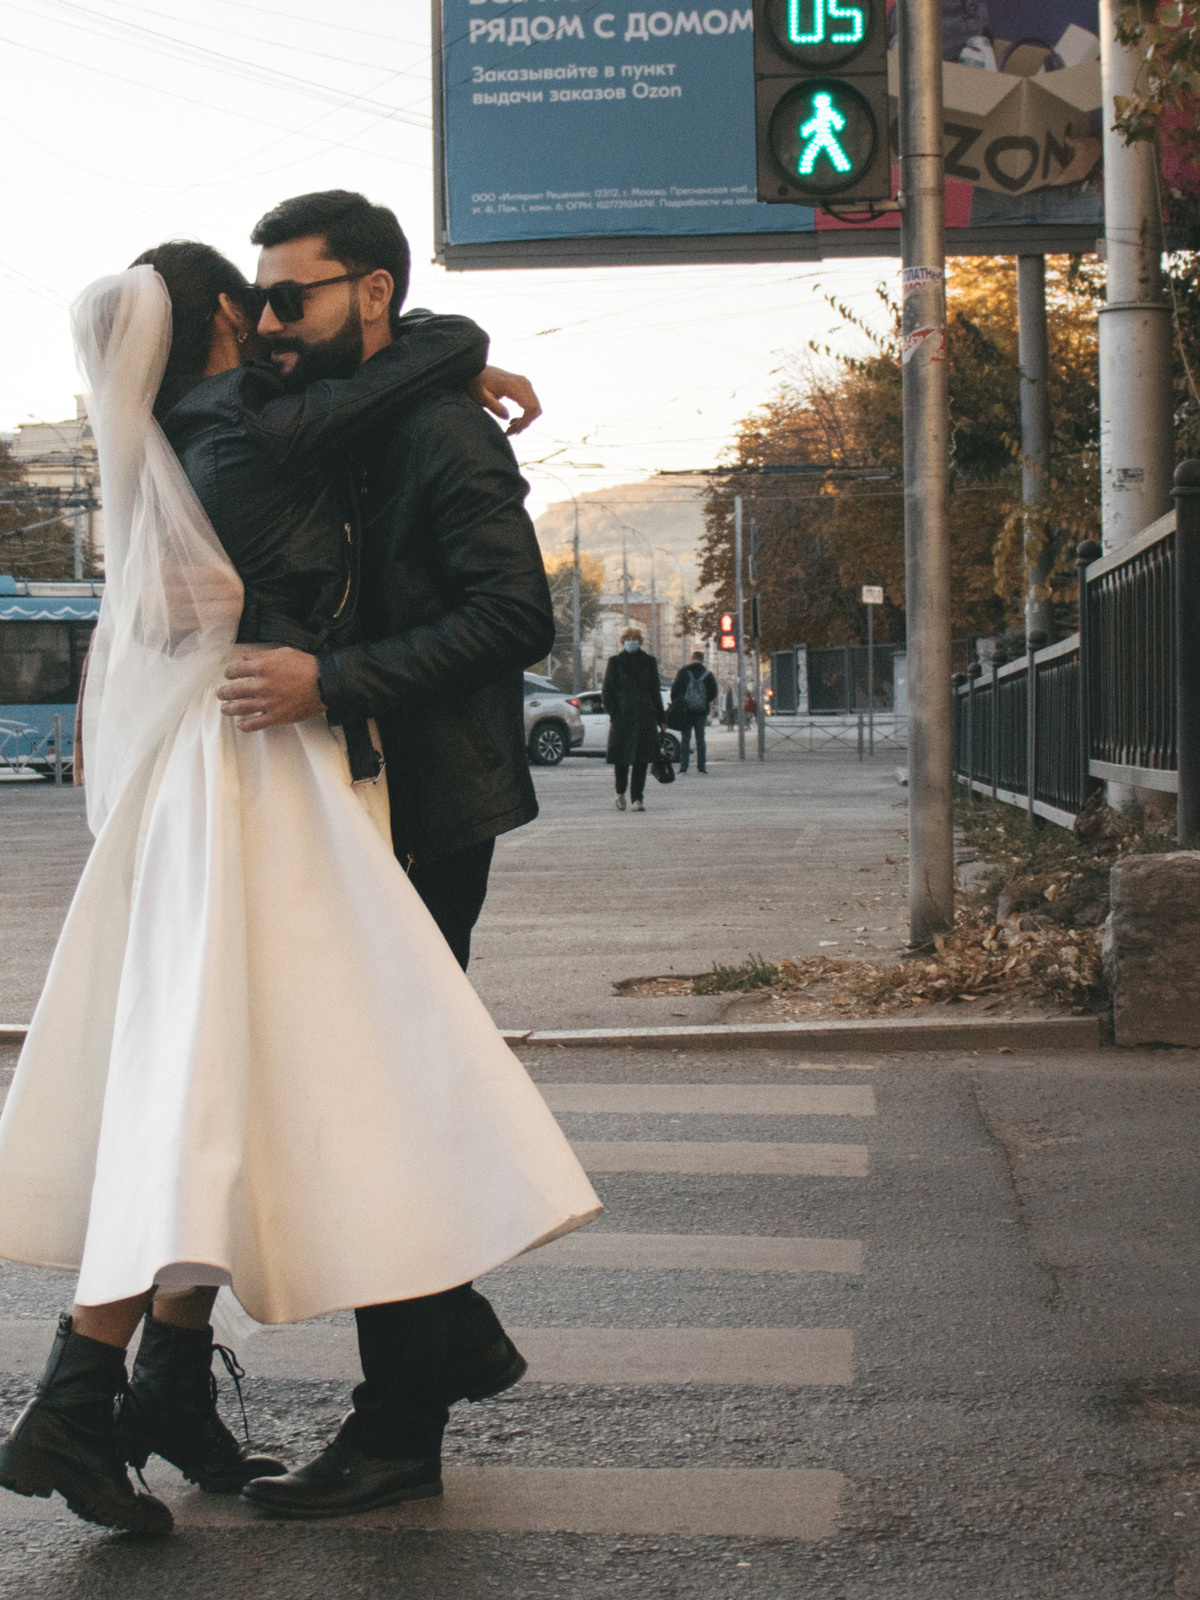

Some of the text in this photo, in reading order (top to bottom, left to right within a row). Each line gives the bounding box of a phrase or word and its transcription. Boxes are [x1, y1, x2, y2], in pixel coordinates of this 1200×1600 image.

[469, 9, 753, 46] РЯДОМ С ДОМОМ
[472, 63, 677, 83] Заказывайте в пункт
[473, 83, 682, 106] выдачи заказов Ozon
[891, 118, 1076, 191] ZON
[472, 193, 496, 203] ООО
